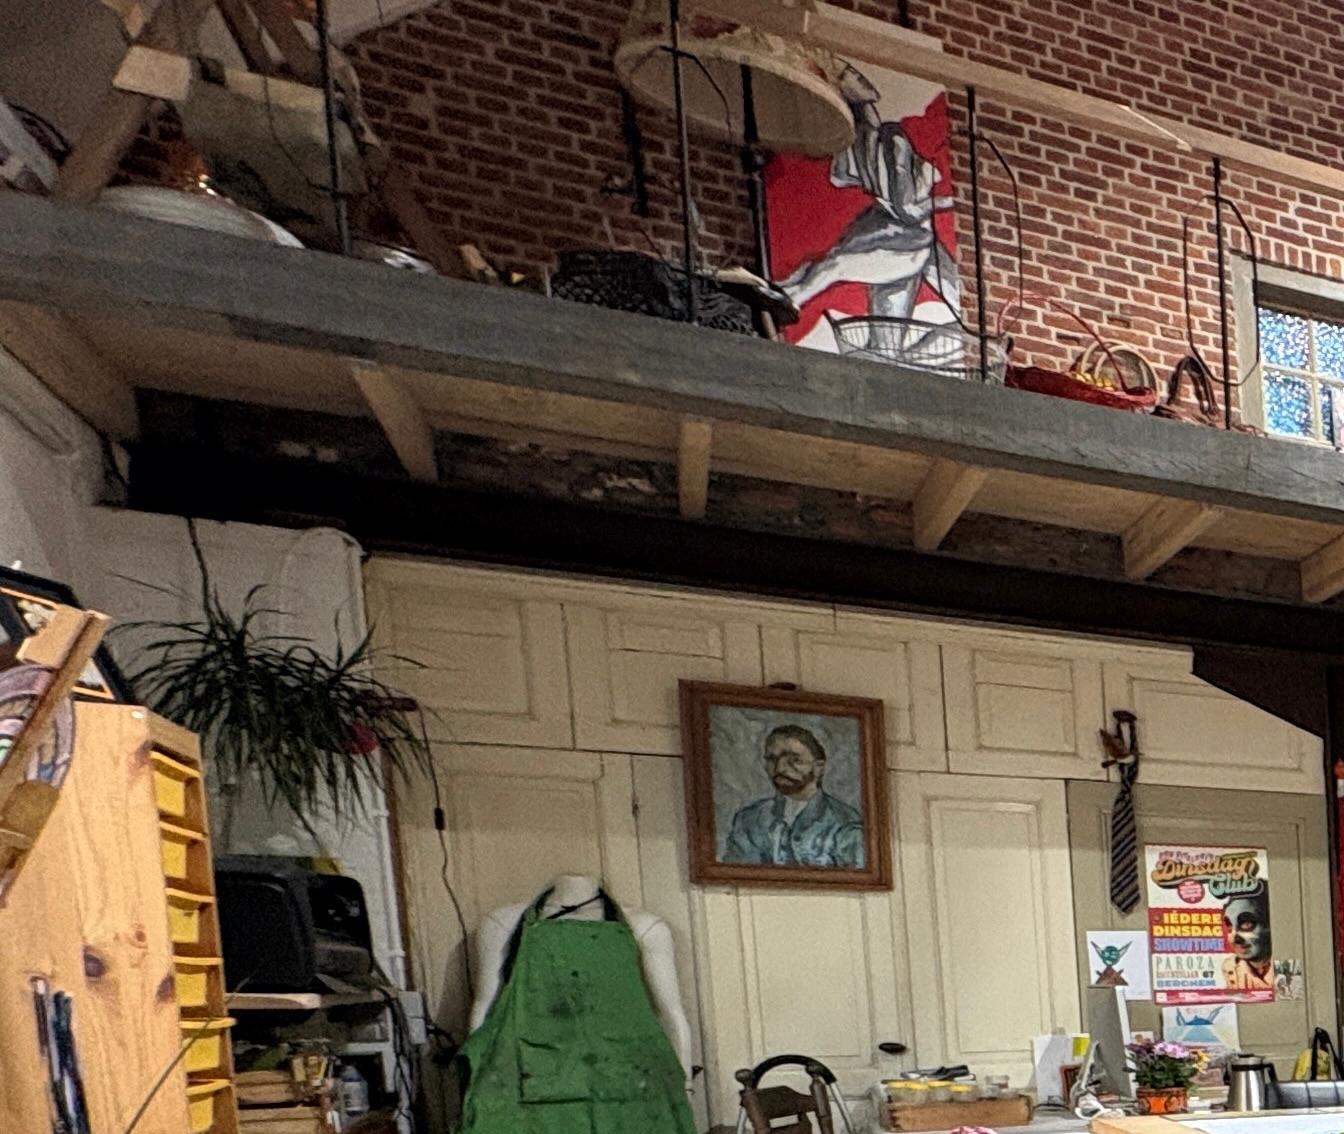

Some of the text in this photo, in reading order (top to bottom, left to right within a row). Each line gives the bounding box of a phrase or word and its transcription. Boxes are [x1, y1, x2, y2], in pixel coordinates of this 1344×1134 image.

[1151, 857, 1259, 881] Dinsdag
[1209, 873, 1258, 896] Club
[1152, 925, 1224, 937] DINSDAG
[1154, 938, 1224, 952] SHOWTIME
[1156, 956, 1215, 970] PAROZA
